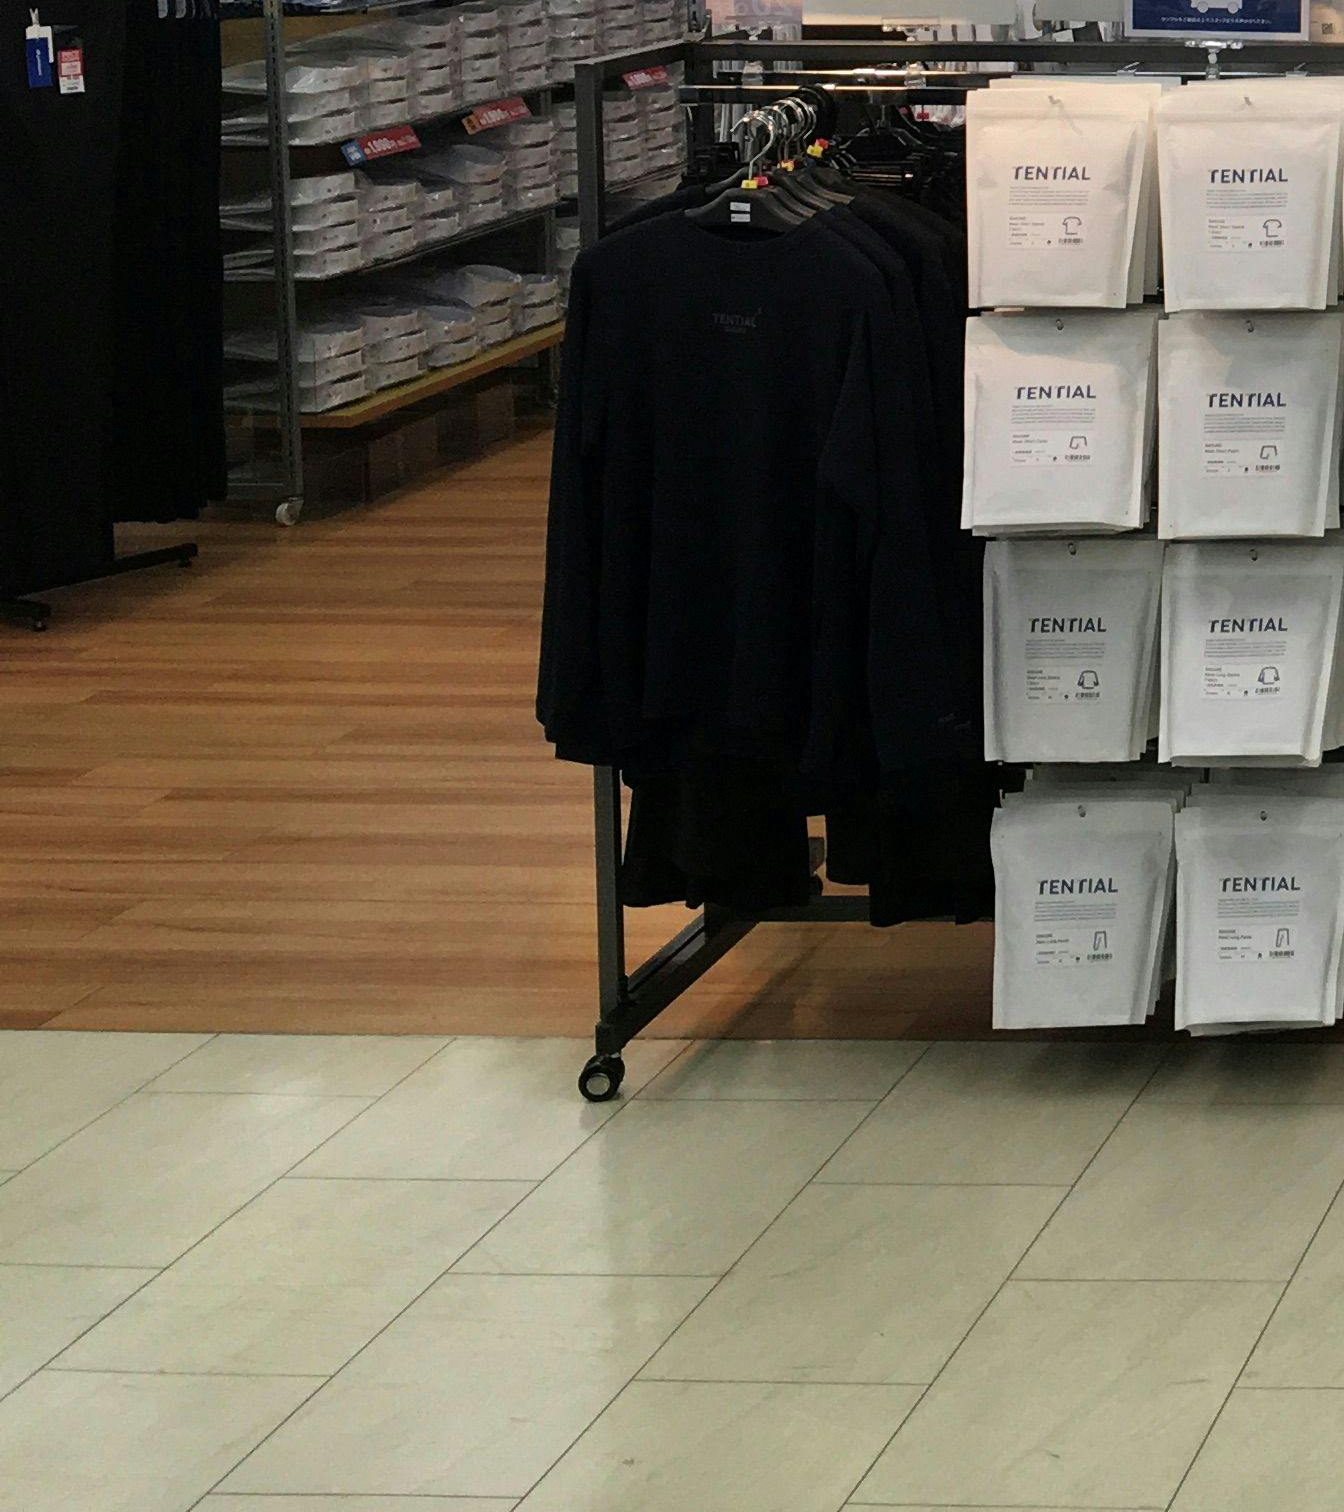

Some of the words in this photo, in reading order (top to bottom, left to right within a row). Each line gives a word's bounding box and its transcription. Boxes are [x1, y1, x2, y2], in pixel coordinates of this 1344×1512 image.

[1012, 166, 1090, 180] TENTIAL
[1208, 168, 1288, 183] TENTIAL
[1014, 385, 1096, 399] TENTIAL
[1206, 393, 1286, 407] TENTIAL
[1028, 617, 1106, 633] TENTIAL
[1207, 618, 1287, 633] TENTIAL
[1037, 878, 1118, 895] TENTIAL
[1220, 877, 1300, 892] TENTIAL
